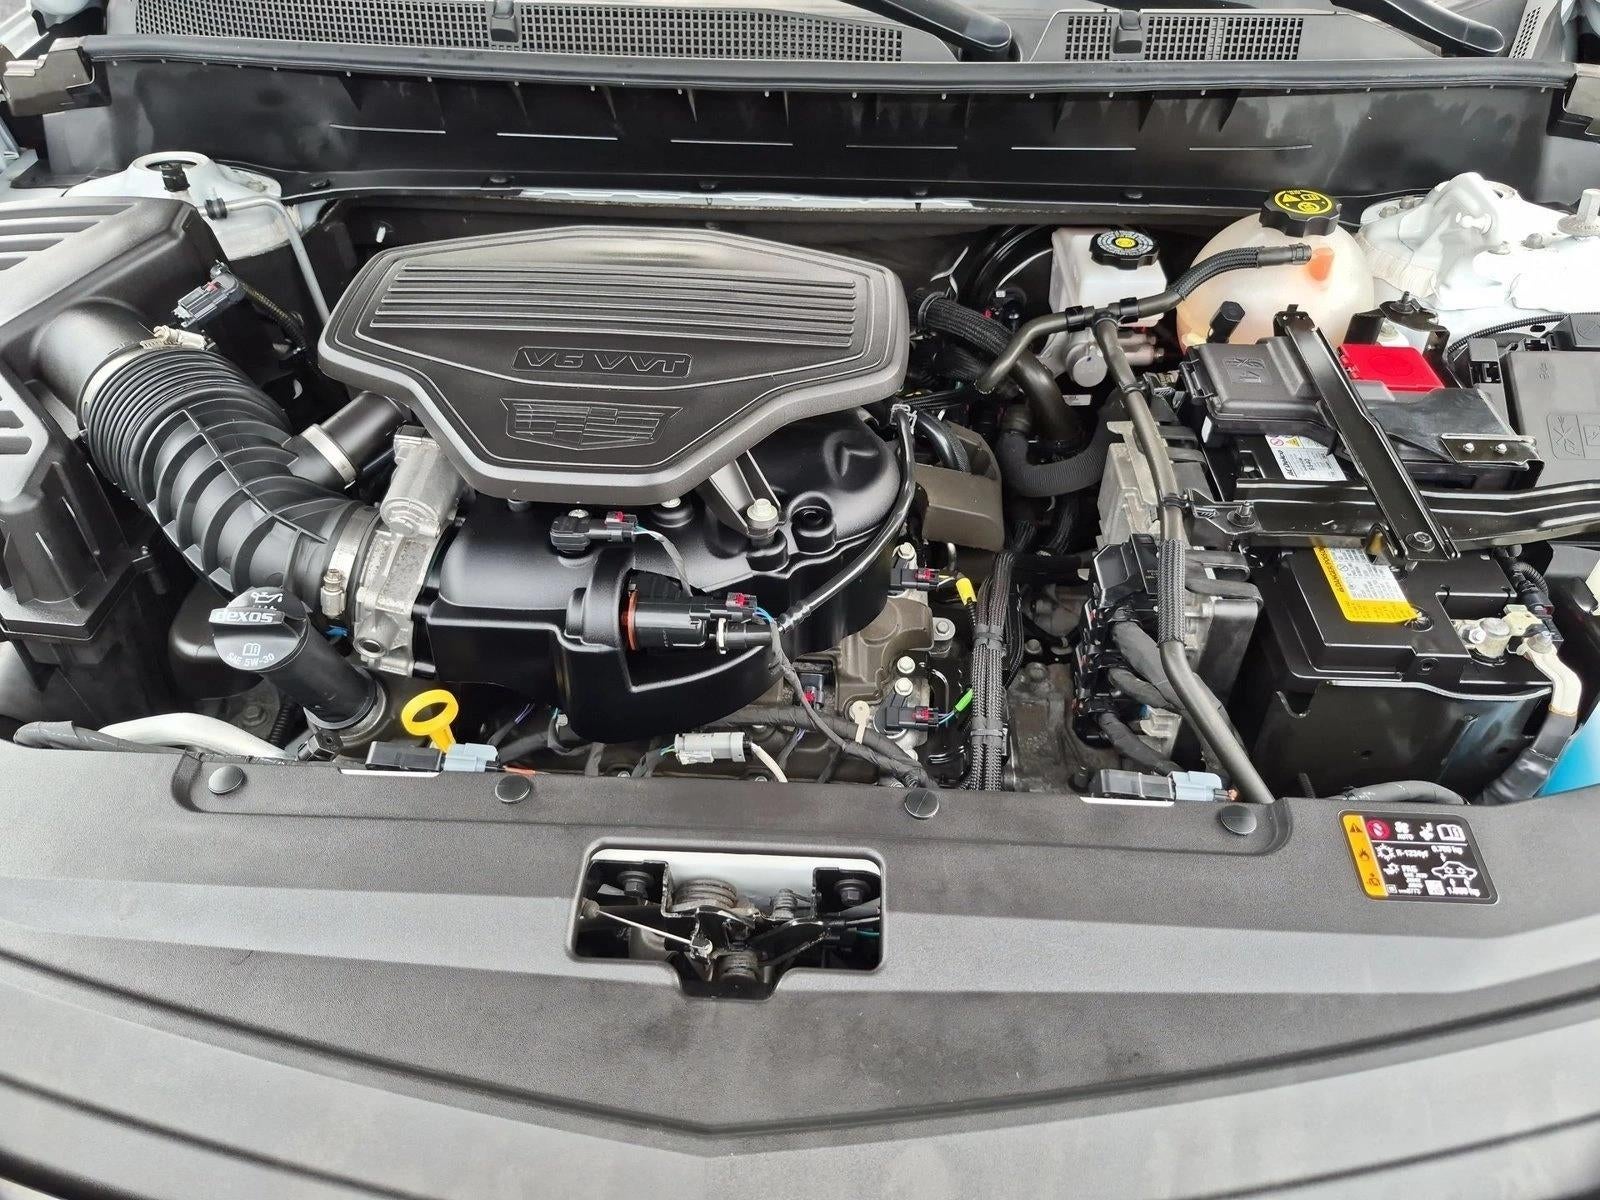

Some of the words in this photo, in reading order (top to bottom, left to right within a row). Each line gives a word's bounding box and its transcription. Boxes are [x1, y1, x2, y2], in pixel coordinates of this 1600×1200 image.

[523, 351, 584, 369] V6
[594, 353, 686, 373] VVT
[226, 652, 242, 665] SAE
[244, 653, 275, 667] 5W-30
